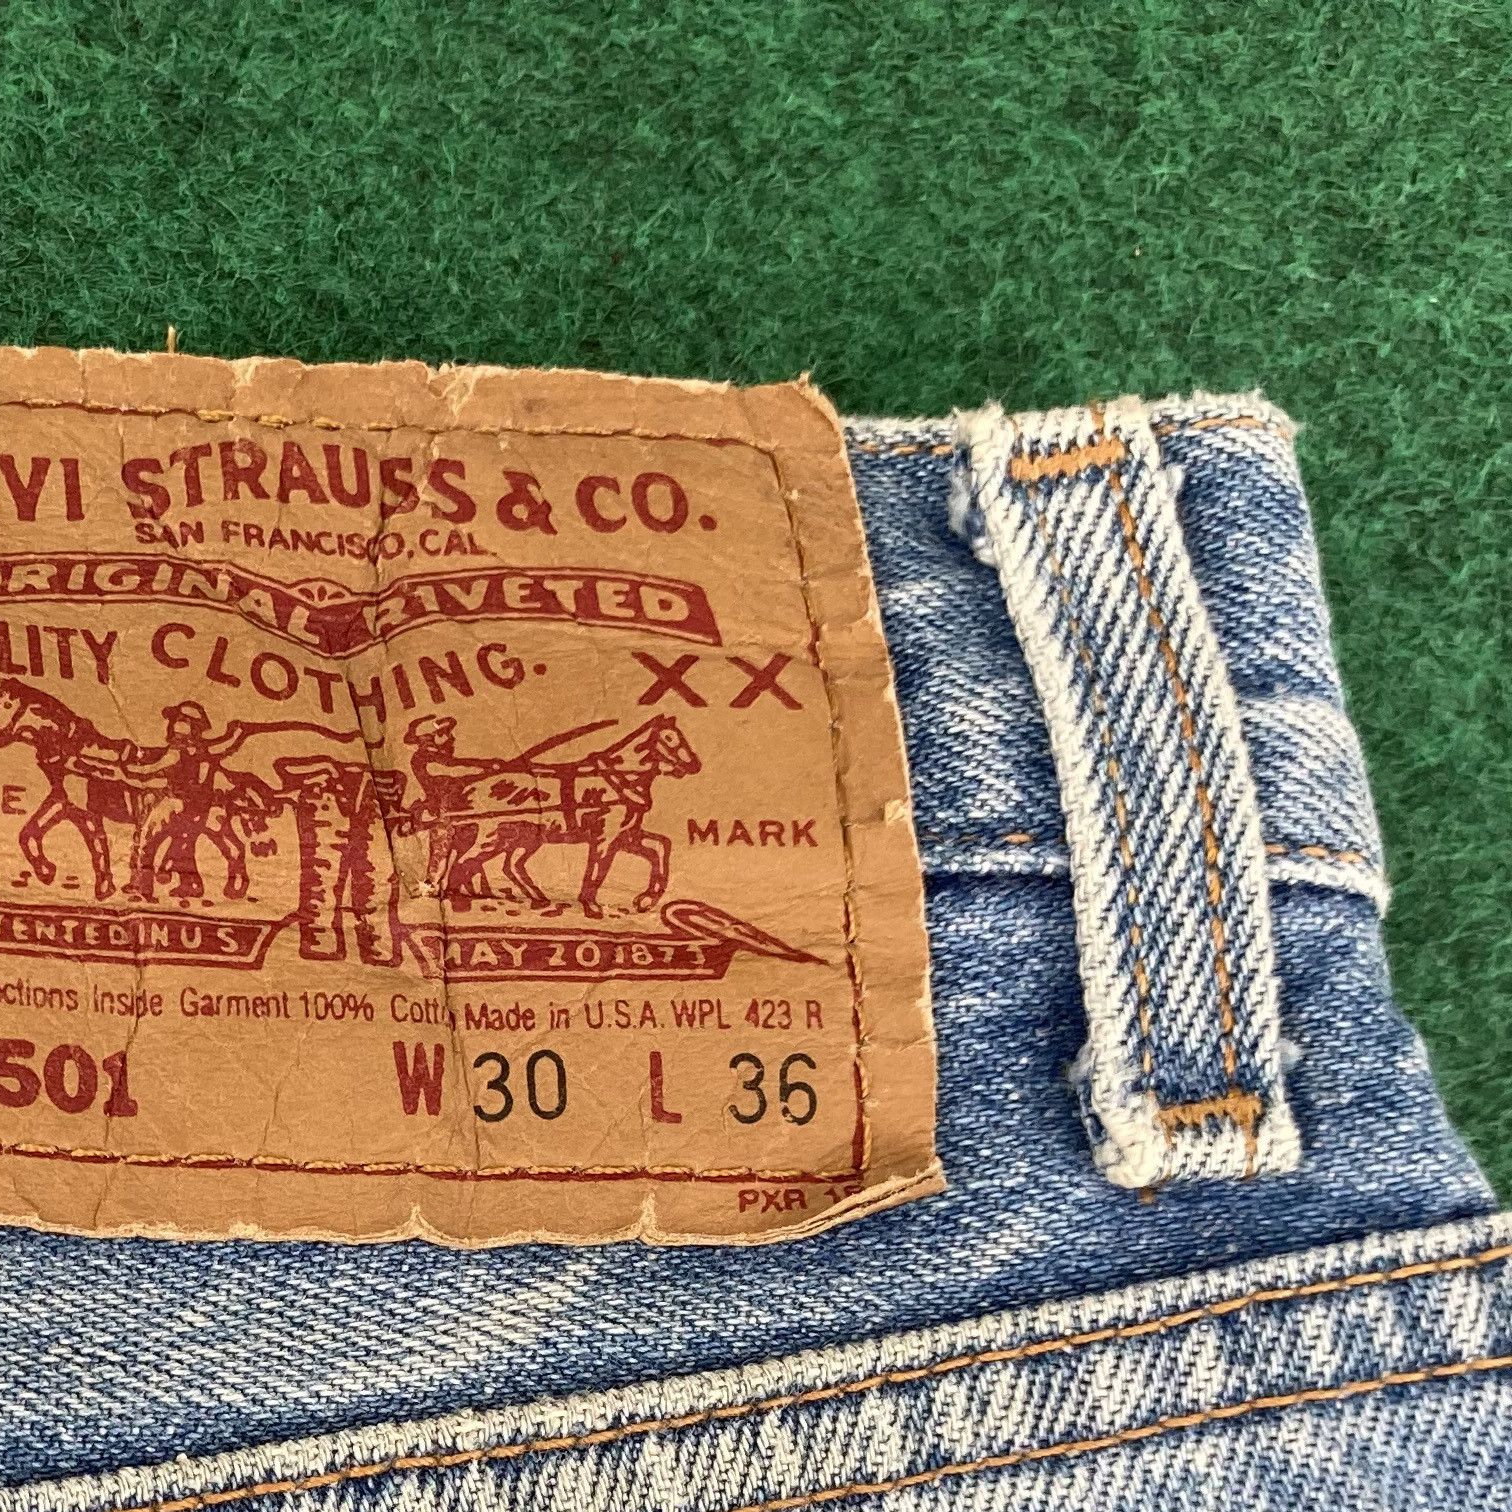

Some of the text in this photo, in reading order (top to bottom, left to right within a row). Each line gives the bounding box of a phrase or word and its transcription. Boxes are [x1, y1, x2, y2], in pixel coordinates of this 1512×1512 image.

[120, 440, 478, 524] STRAUSS
[495, 470, 558, 536] &
[575, 471, 719, 536] CO.
[134, 520, 205, 551] SAN
[150, 622, 548, 726] CLOTHING.
[688, 818, 819, 850] MARK
[139, 922, 170, 947] IN
[548, 940, 601, 968] 20
[614, 943, 707, 967] 1873
[93, 983, 164, 1019] Inside
[179, 987, 290, 1020] Garment
[299, 990, 374, 1022] 100%
[464, 1001, 536, 1032] Made
[549, 1001, 571, 1030] in
[584, 1000, 666, 1031] U.S.A.
[670, 998, 732, 1030] WPL
[744, 999, 793, 1031] 423
[805, 1000, 824, 1031] R
[393, 1040, 445, 1117] W
[472, 1049, 568, 1123] 30
[649, 1051, 683, 1124] L
[728, 1052, 819, 1126] 36
[738, 1188, 808, 1214] PXR
